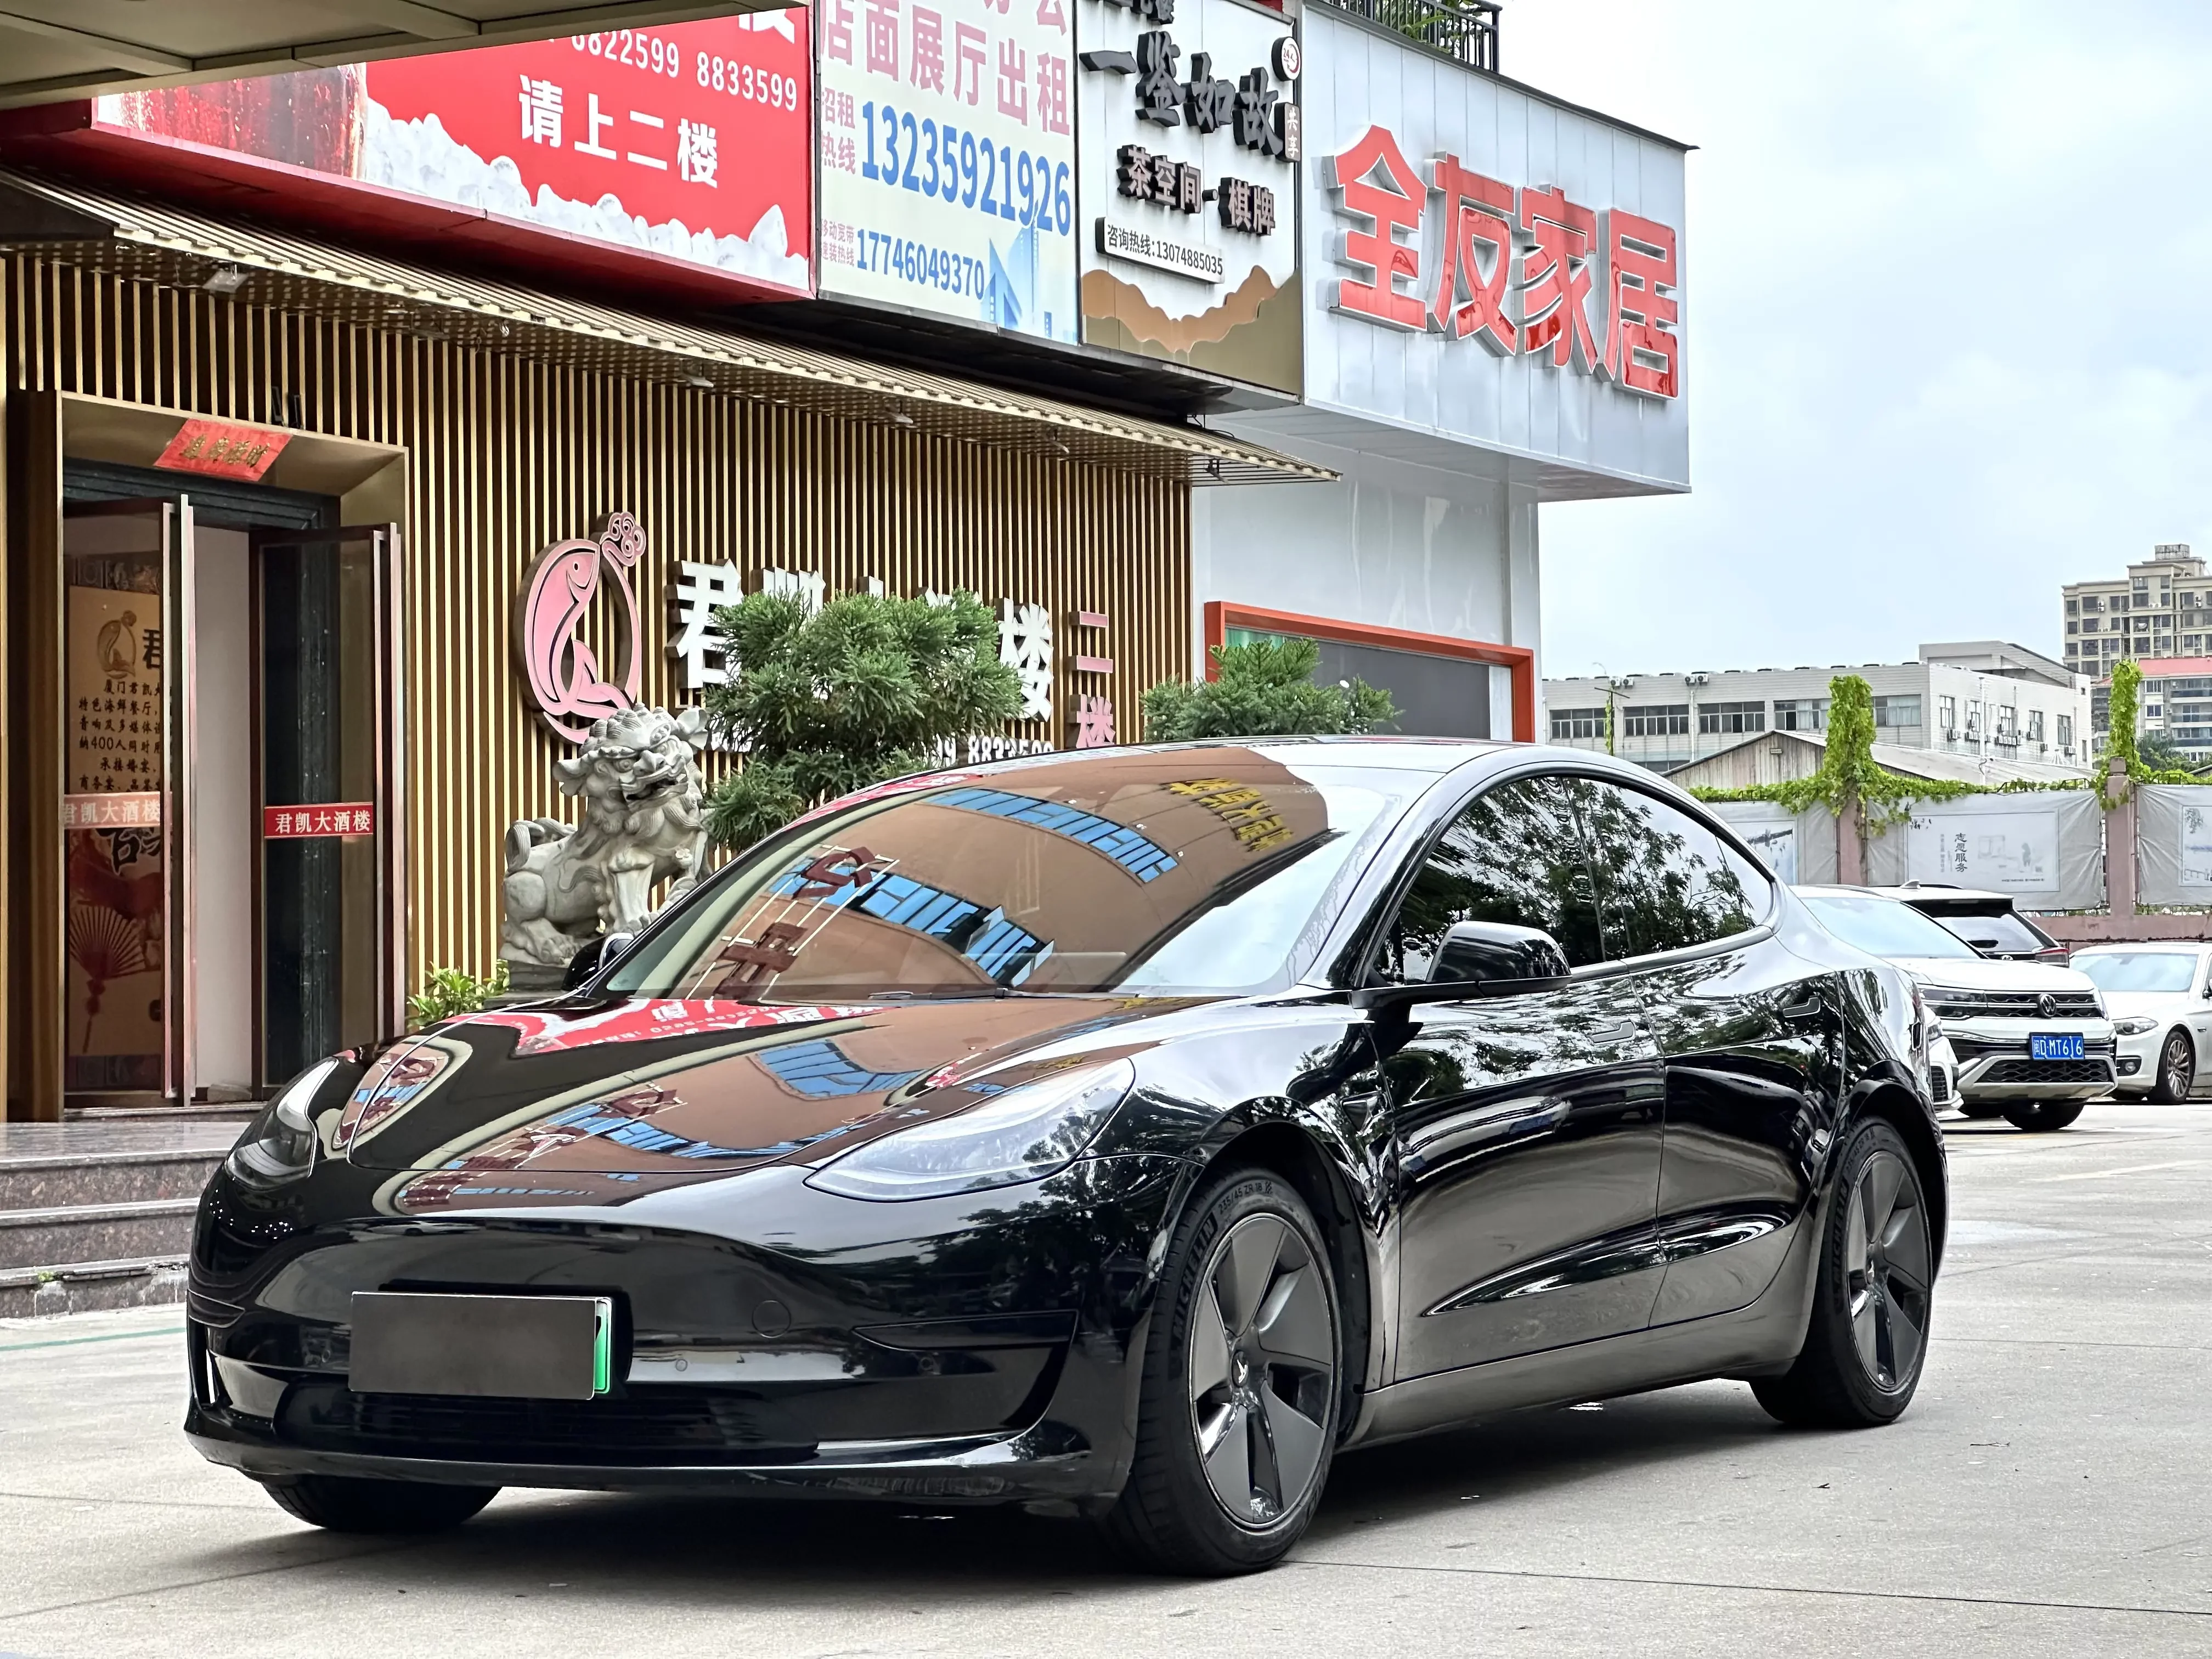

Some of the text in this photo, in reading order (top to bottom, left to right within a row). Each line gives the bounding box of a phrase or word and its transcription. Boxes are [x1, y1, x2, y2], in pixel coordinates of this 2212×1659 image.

[697, 51, 797, 112] 8833599
[820, 0, 1070, 136] 店面展厅出租
[518, 75, 718, 188] 请上二楼
[821, 87, 856, 129] 招租
[821, 131, 856, 175] 热线
[862, 101, 1071, 236] 13235921926
[857, 228, 984, 300] 17746049370
[1322, 124, 1679, 400] 全友家居
[63, 799, 160, 823] 君凯大酒楼
[275, 810, 371, 834] 君凯大酒楼
[1954, 832, 1968, 873] 志愿服务
